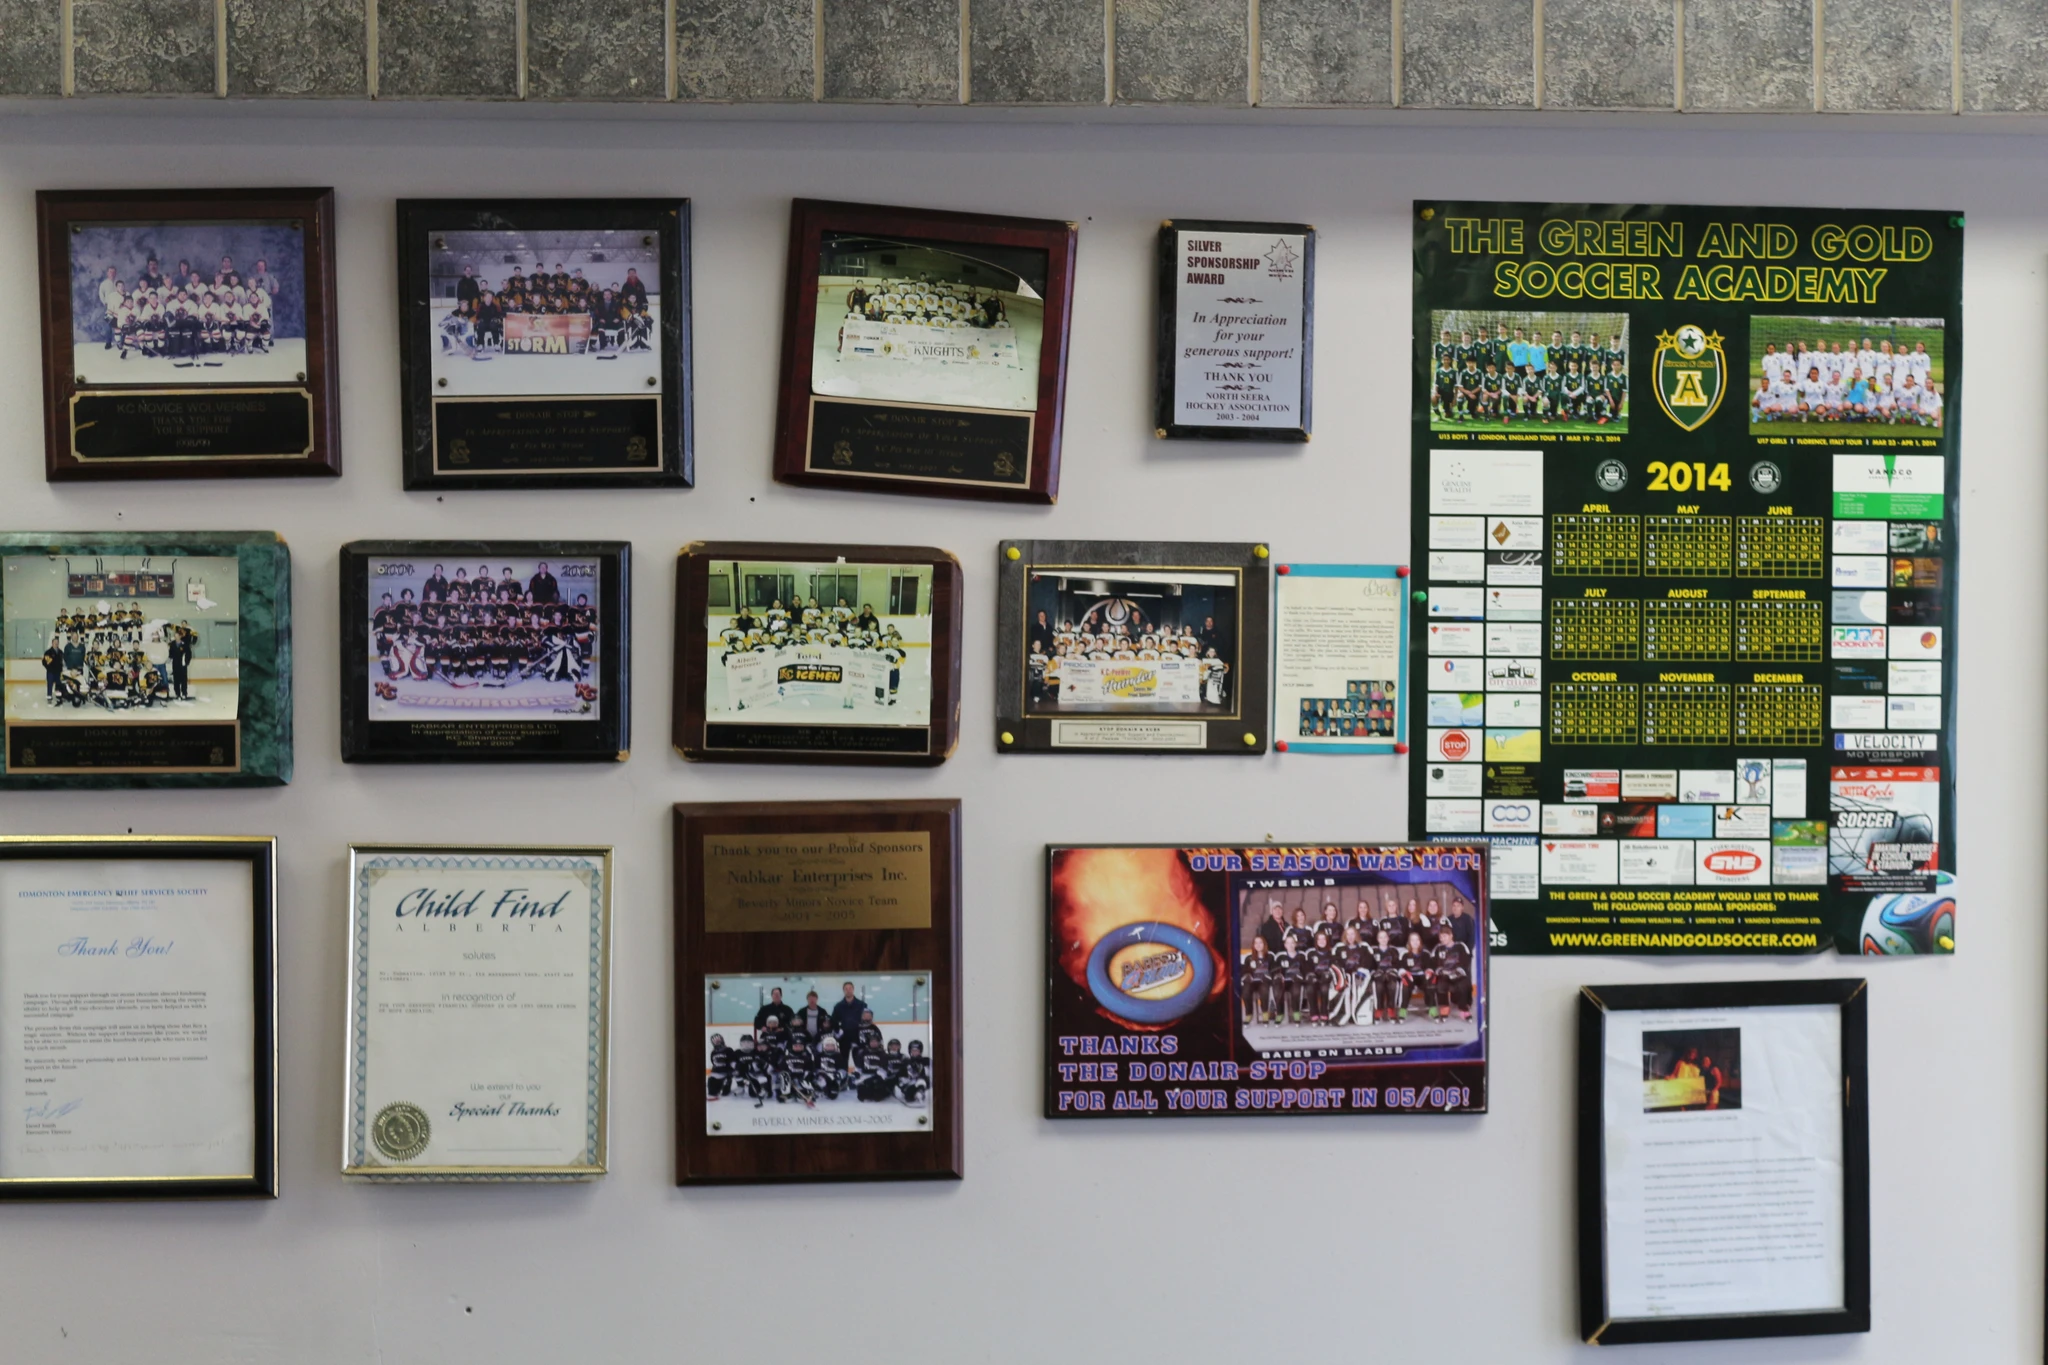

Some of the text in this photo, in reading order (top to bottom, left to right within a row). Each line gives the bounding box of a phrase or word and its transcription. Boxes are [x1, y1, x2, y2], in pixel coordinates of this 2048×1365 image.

[1187, 240, 1222, 252] SILVER
[1445, 218, 1934, 263] THE GREEN AND GOLD
[1187, 256, 1260, 270] SPONSORSHIP
[1186, 272, 1225, 285] AWARD
[1494, 261, 1888, 304] SOCCER ACADEMY
[1192, 312, 1287, 326] In Appreciation
[1213, 329, 1265, 344] for your
[507, 335, 568, 354] STORM
[913, 344, 966, 358] KNIGHTS
[1184, 347, 1294, 361] generous support!
[1204, 372, 1274, 383] THANK YOU
[1670, 370, 1708, 406] A
[1206, 392, 1271, 402] NORTH SEERA
[1186, 402, 1290, 412] HOCKEY ASSOCIATION
[1216, 413, 1260, 422] 2003 2004
[1540, 434, 1556, 442] TOUR
[1646, 461, 1732, 492] 2014
[1582, 504, 1793, 515] APRIL MAY JUNE
[1584, 588, 1806, 600] JULY AUGUST SEPTEMBER
[796, 670, 842, 682] ICEMEN
[1571, 672, 1804, 683] OCTOBER NOVEMBER DECEMBER
[1444, 740, 1466, 750] STOP
[1854, 735, 1926, 750] VELOCITY
[1837, 812, 1895, 828] SOCCER
[1491, 837, 1537, 846] MACHINE
[712, 842, 924, 858] Thank you to our Proud Sponsors
[1192, 854, 1481, 872] OUR SEASON WAS HOT!
[727, 868, 908, 886] Nabkar Enterprises Inc.
[1246, 878, 1336, 888] TWEEN B
[18, 890, 64, 898] EDMONTON
[66, 890, 113, 898] EMERGENCY
[177, 888, 208, 896] SOCIETY
[1550, 892, 1566, 900] THE
[1568, 892, 1597, 900] GREEN
[1610, 892, 1634, 900] GOLD
[1637, 892, 1670, 900] SOCCER
[1673, 892, 1716, 900] ACADEMY
[1718, 892, 1752, 900] WOULD
[1754, 892, 1772, 900] LIKE
[1774, 892, 1786, 900] TO
[1788, 893, 1819, 901] THANK
[395, 888, 572, 918] Child Find
[868, 896, 898, 906] Team
[1593, 902, 1777, 912] THE FOLLOWING GOLD MEDAL SPONSORS:
[396, 923, 563, 932] ALBERTA
[1550, 933, 1817, 947] WWW.GREENANDGOLDSOCCER.COM
[57, 936, 175, 958] Thank You!
[442, 992, 517, 1004] in recognition of
[1059, 1035, 1179, 1055] THANKS
[1262, 1047, 1404, 1059] BABES ON BLADES
[1059, 1060, 1326, 1082] THE DONAIR STOP
[526, 1084, 542, 1092] you
[1059, 1086, 1470, 1110] FOR ALL YOUR SUPPORT IN 05/06!
[449, 1102, 561, 1122] Special Thanks
[752, 1115, 793, 1127] BEVERLY
[796, 1114, 836, 1126] MINERS
